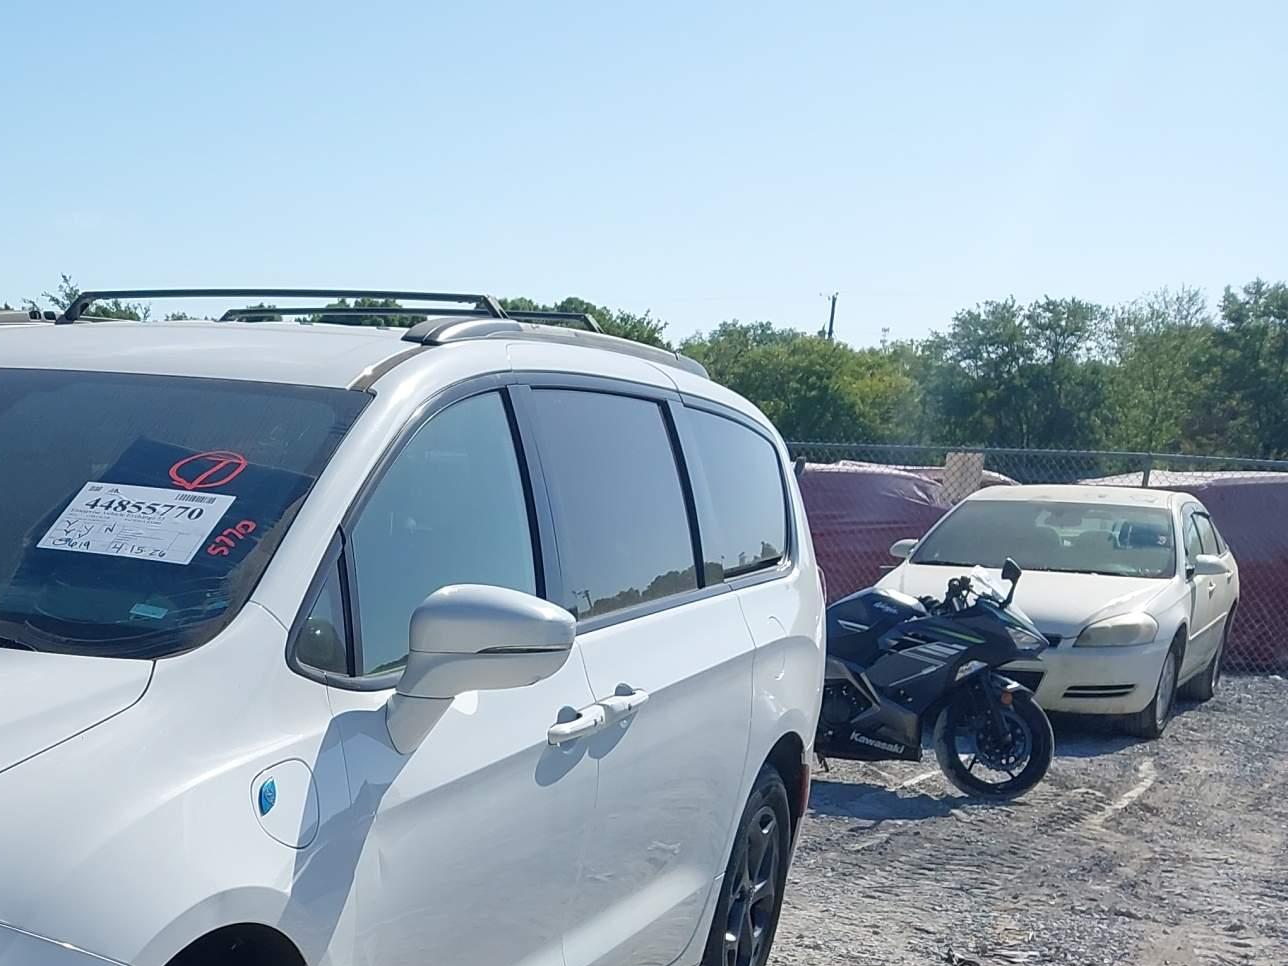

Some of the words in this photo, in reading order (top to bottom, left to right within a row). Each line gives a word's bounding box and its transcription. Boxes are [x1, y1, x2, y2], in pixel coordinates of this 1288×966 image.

[85, 497, 204, 521] 44855770
[207, 520, 257, 556] 5770
[850, 729, 905, 754] Kawasaki
